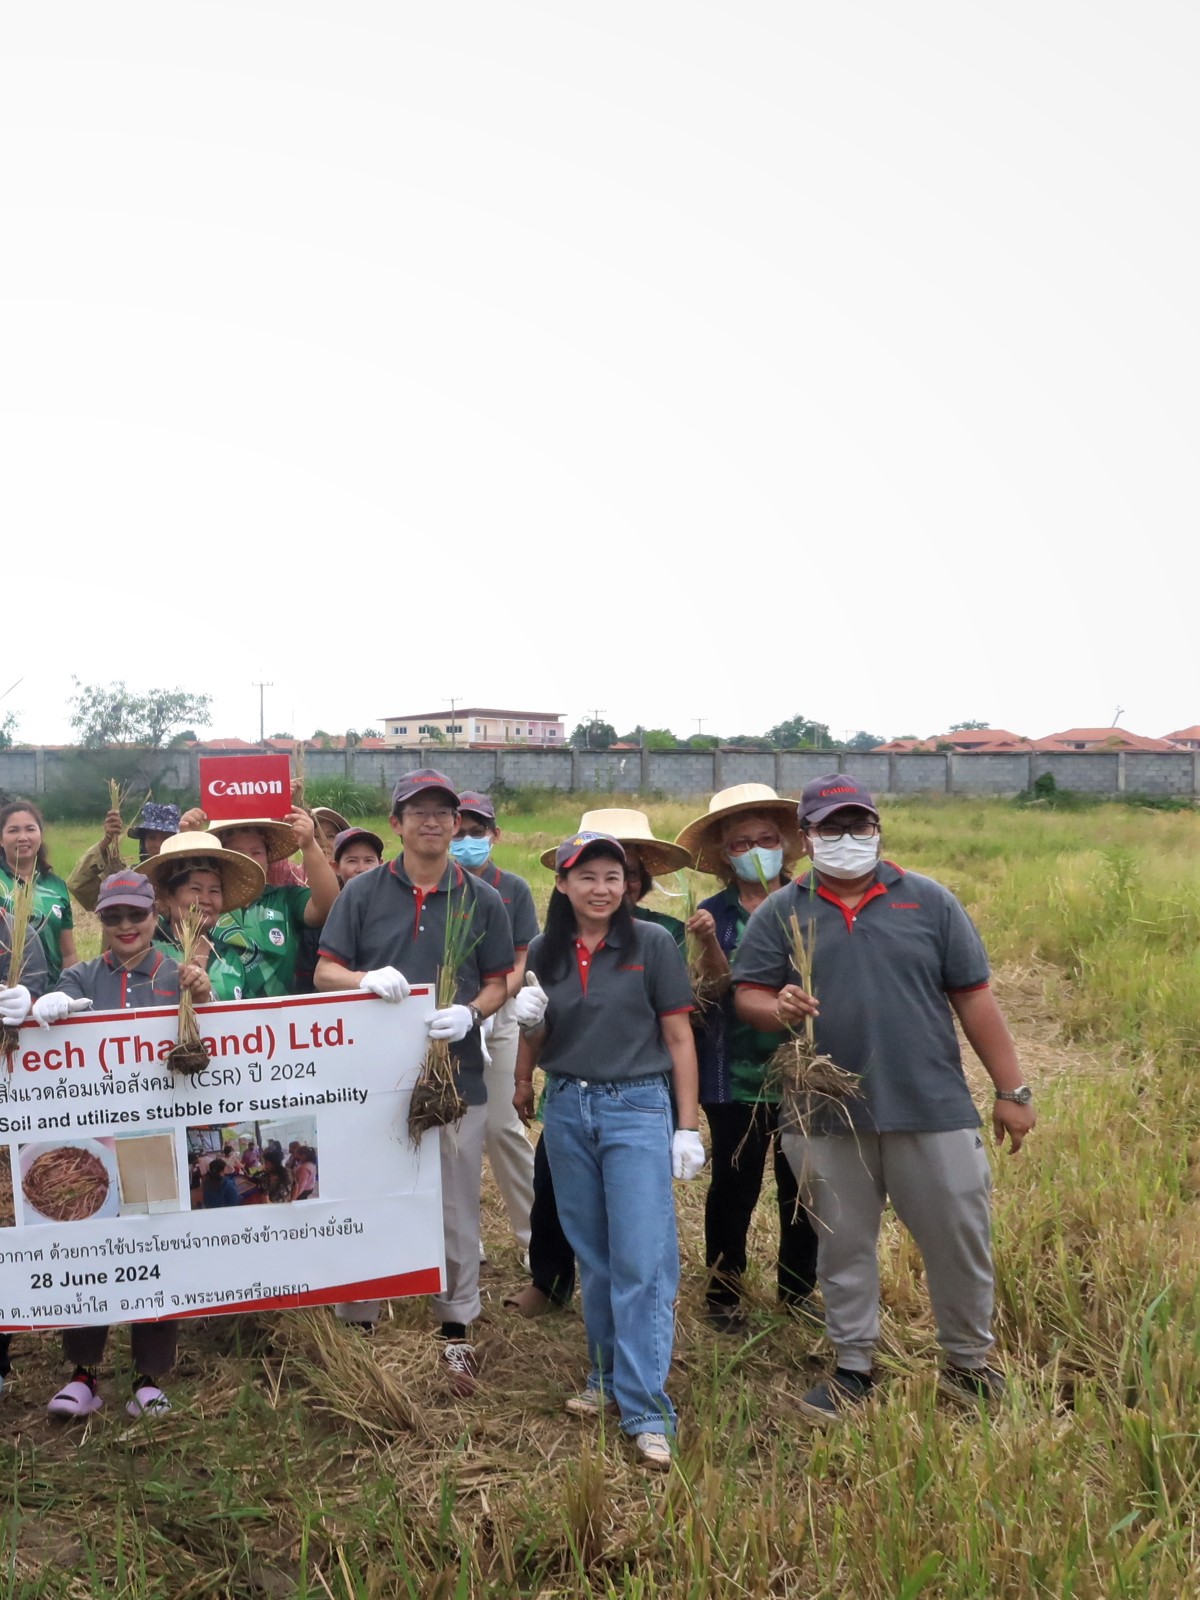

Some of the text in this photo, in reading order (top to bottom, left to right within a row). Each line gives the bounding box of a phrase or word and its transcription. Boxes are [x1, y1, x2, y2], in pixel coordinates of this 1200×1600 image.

[208, 780, 282, 797] Canon
[99, 1024, 276, 1072] (Thaand)
[289, 1018, 355, 1050] Ltd.
[190, 1066, 241, 1090] (CSR)
[248, 1061, 262, 1083] ปี
[271, 1061, 317, 1081] 2024
[38, 1112, 71, 1130] and
[76, 1107, 140, 1127] utilizes
[146, 1100, 213, 1121] stubble
[218, 1098, 244, 1114] for
[249, 1086, 369, 1111] sustainability
[30, 1264, 161, 1290] 28 June 2024
